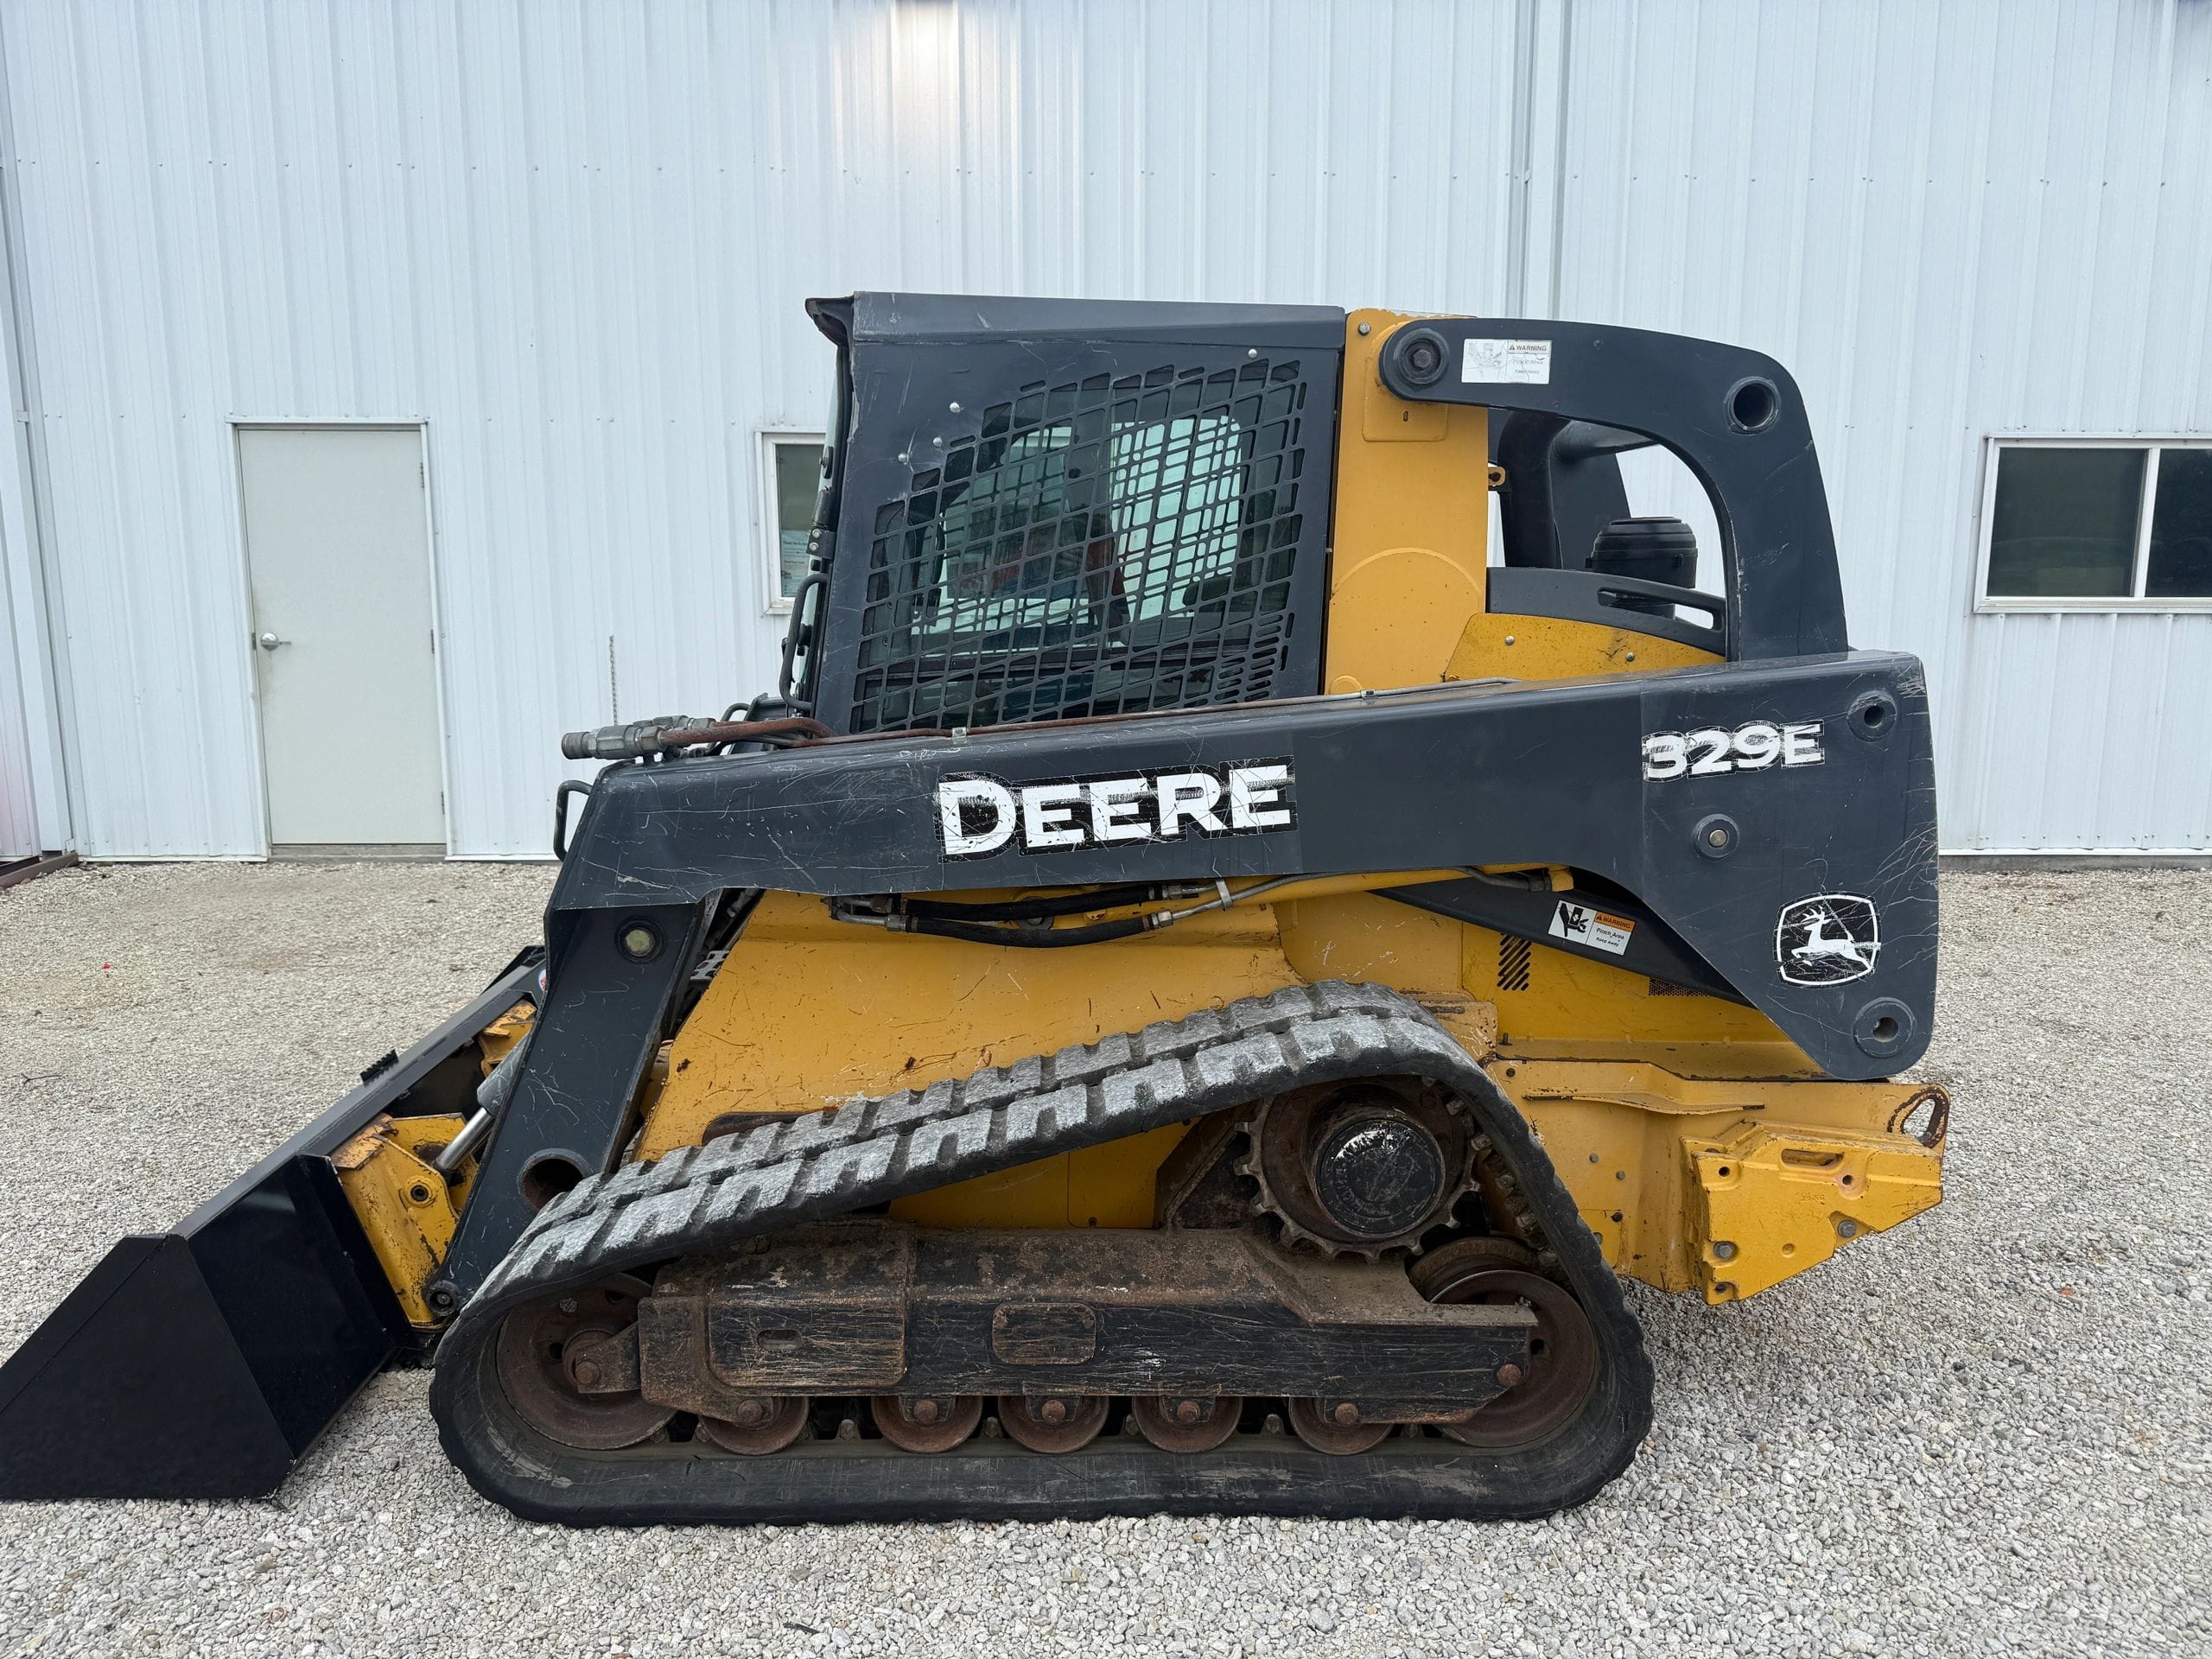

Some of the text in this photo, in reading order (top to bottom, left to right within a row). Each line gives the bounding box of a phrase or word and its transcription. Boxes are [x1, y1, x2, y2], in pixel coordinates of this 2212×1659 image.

[1643, 722, 1824, 779] 329E
[938, 765, 1292, 855] DEERE
[1596, 927, 1612, 936] Pinch
[1603, 916, 1631, 929] WARNING
